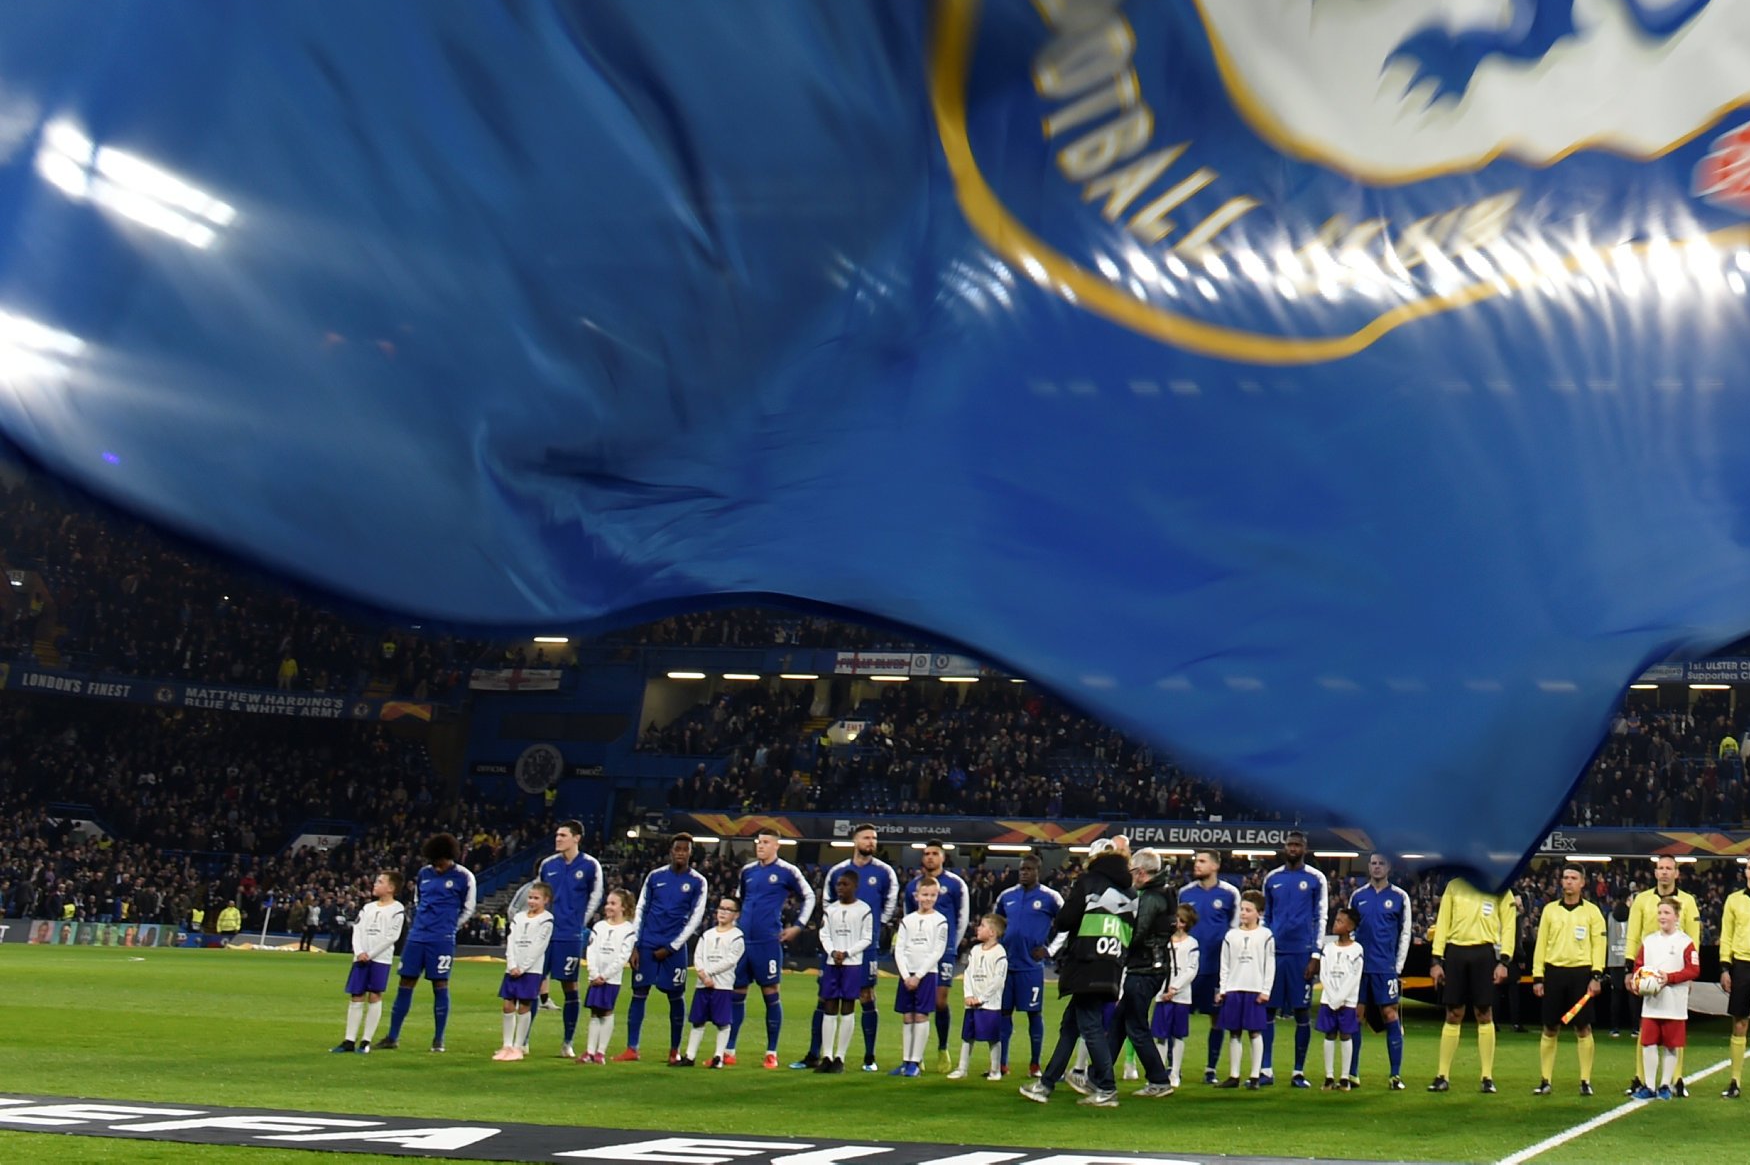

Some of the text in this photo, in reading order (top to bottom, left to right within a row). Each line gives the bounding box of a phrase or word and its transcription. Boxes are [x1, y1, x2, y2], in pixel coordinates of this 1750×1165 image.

[1706, 662, 1738, 671] ULSTER
[1687, 672, 1739, 681] Supporters
[22, 672, 132, 698] LONDON'S FINEST
[185, 687, 344, 709] MATTHEW HARDING'S
[184, 697, 343, 718] BLUE & WHITE ARMY
[1123, 827, 1291, 844] UEFA EUROPA LEAGU
[438, 955, 451, 970] 22
[564, 956, 578, 972] 27
[768, 959, 777, 974] 8
[673, 967, 686, 984] 20
[1032, 986, 1040, 1002] 7
[0, 1098, 502, 1150] EFA
